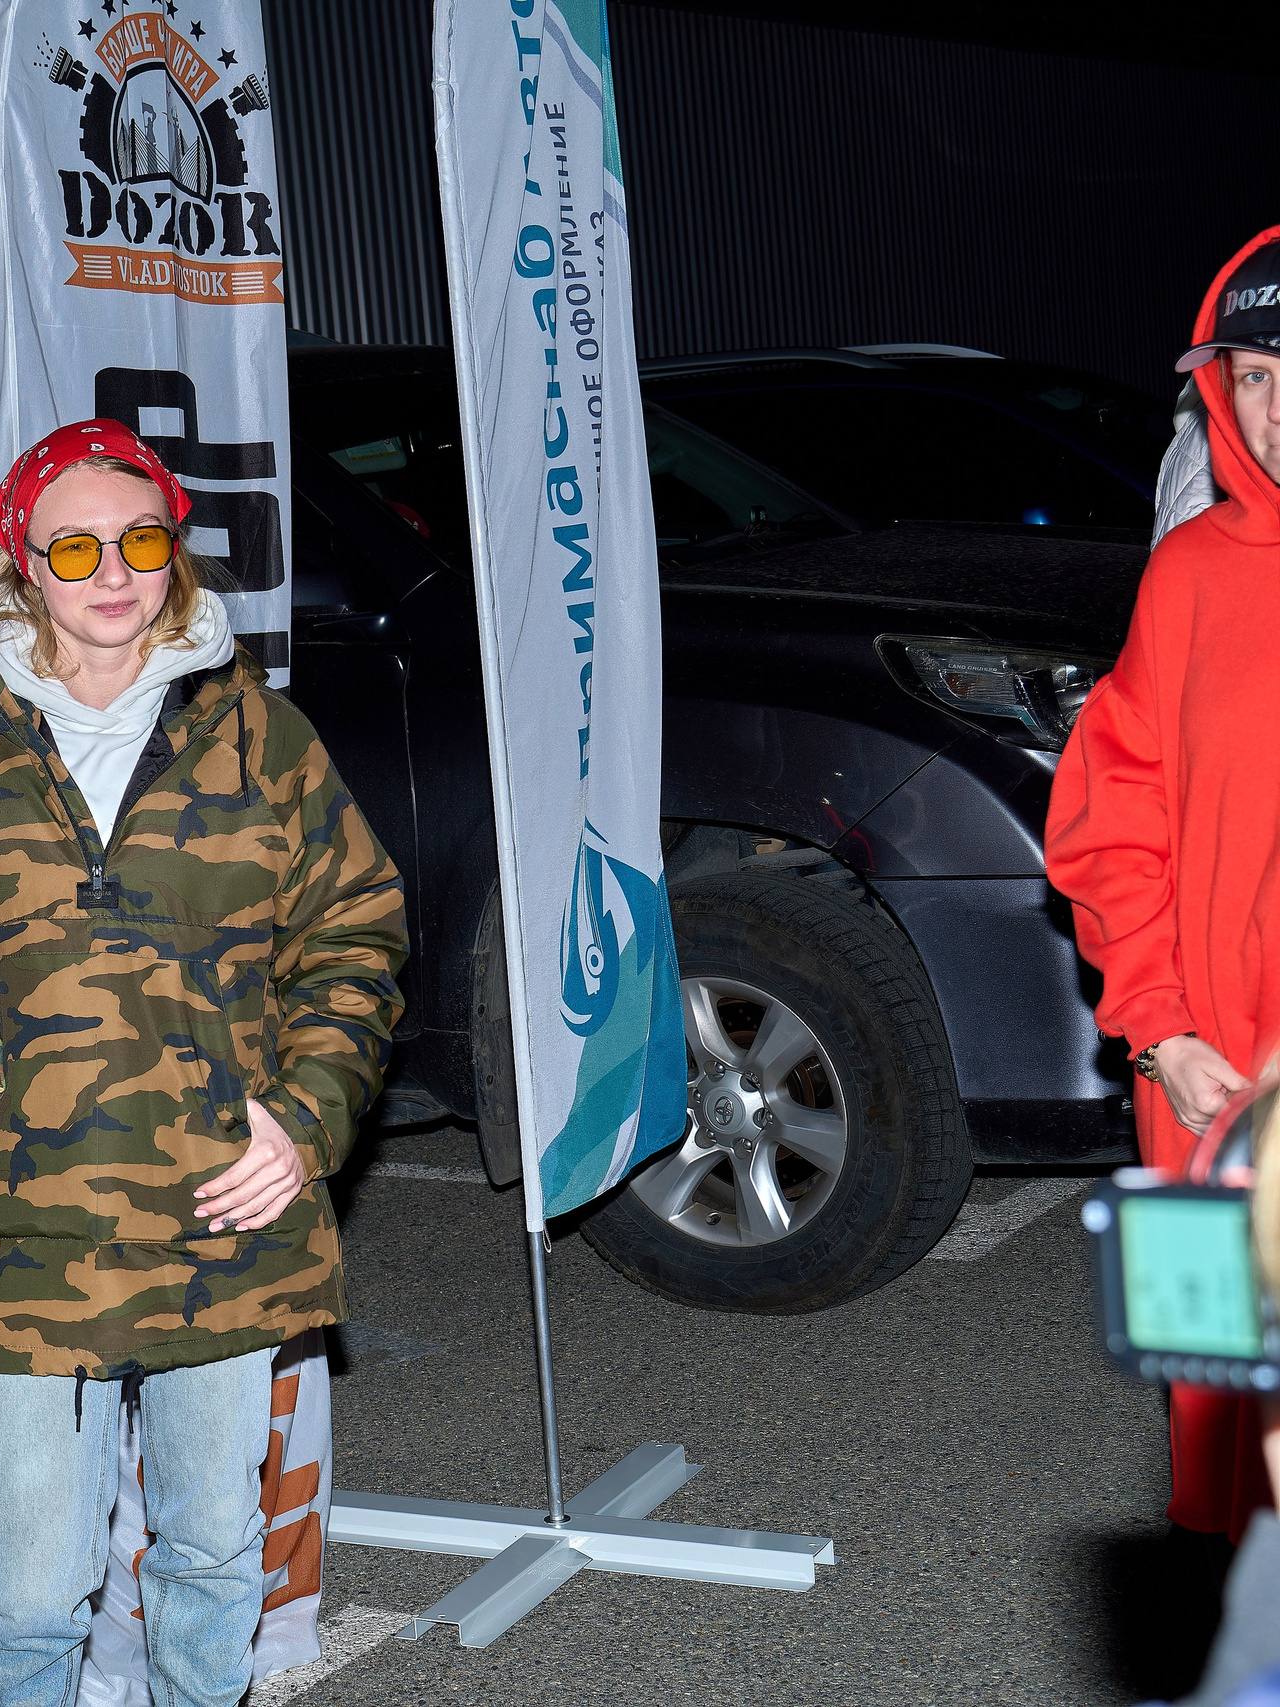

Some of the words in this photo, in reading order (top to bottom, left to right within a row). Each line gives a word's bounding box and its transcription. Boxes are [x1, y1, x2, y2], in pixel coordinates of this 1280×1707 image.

[172, 41, 208, 97] ИГРА
[58, 169, 280, 257] DOZOR
[543, 103, 600, 361] ОФОРМЛЕНИЕ
[1223, 284, 1280, 318] DOZ
